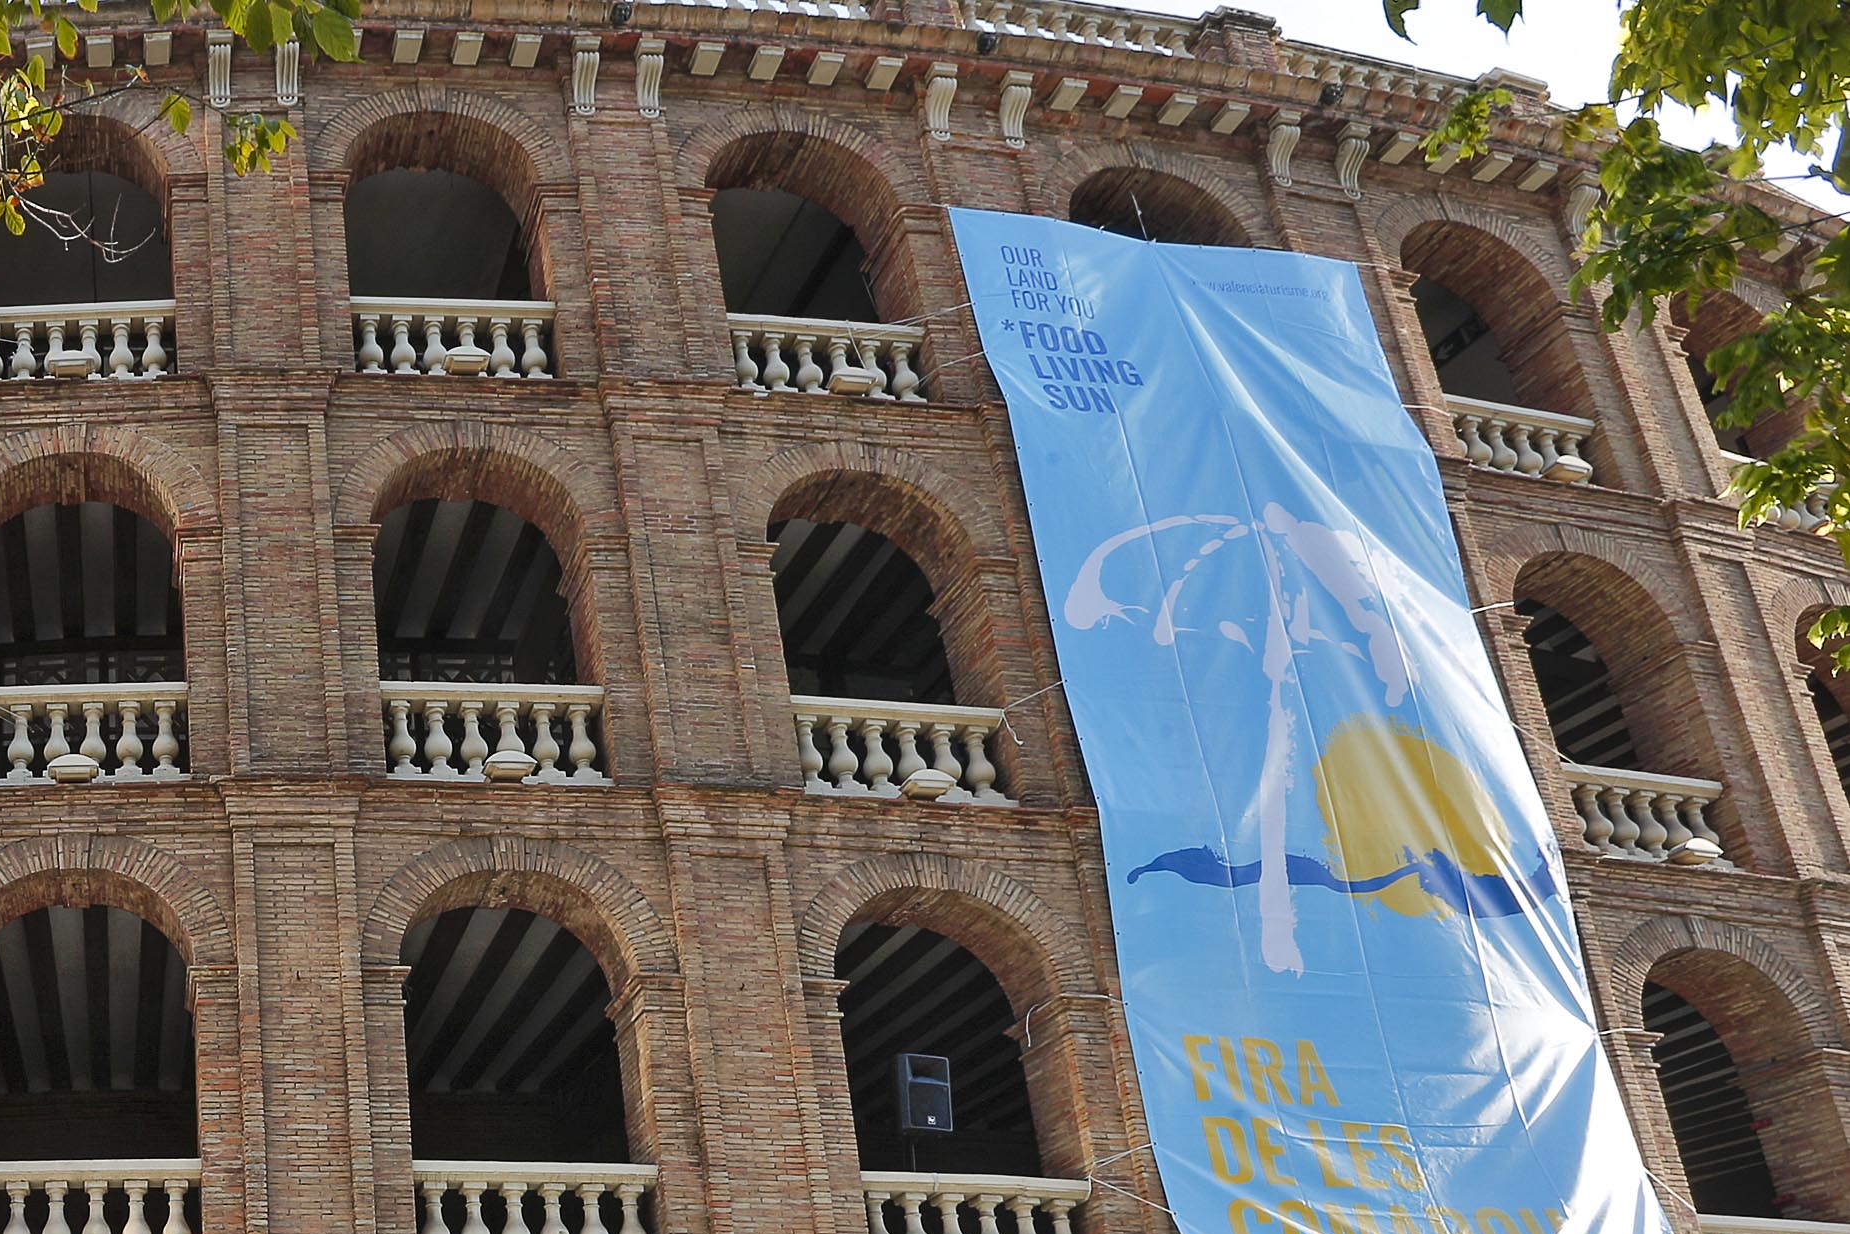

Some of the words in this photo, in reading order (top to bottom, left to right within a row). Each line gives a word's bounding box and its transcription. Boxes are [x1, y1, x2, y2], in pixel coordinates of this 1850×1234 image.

[1001, 245, 1044, 268] OUR
[1005, 267, 1058, 291] LAND
[1011, 289, 1051, 313] FOR
[1055, 294, 1095, 320] YOU
[1018, 320, 1108, 356] FOOD
[1028, 353, 1144, 387] LIVING
[1043, 383, 1117, 414] SUN
[1181, 1033, 1341, 1107] FIRA
[1201, 1115, 1297, 1187] DE
[1304, 1119, 1426, 1193] LES
